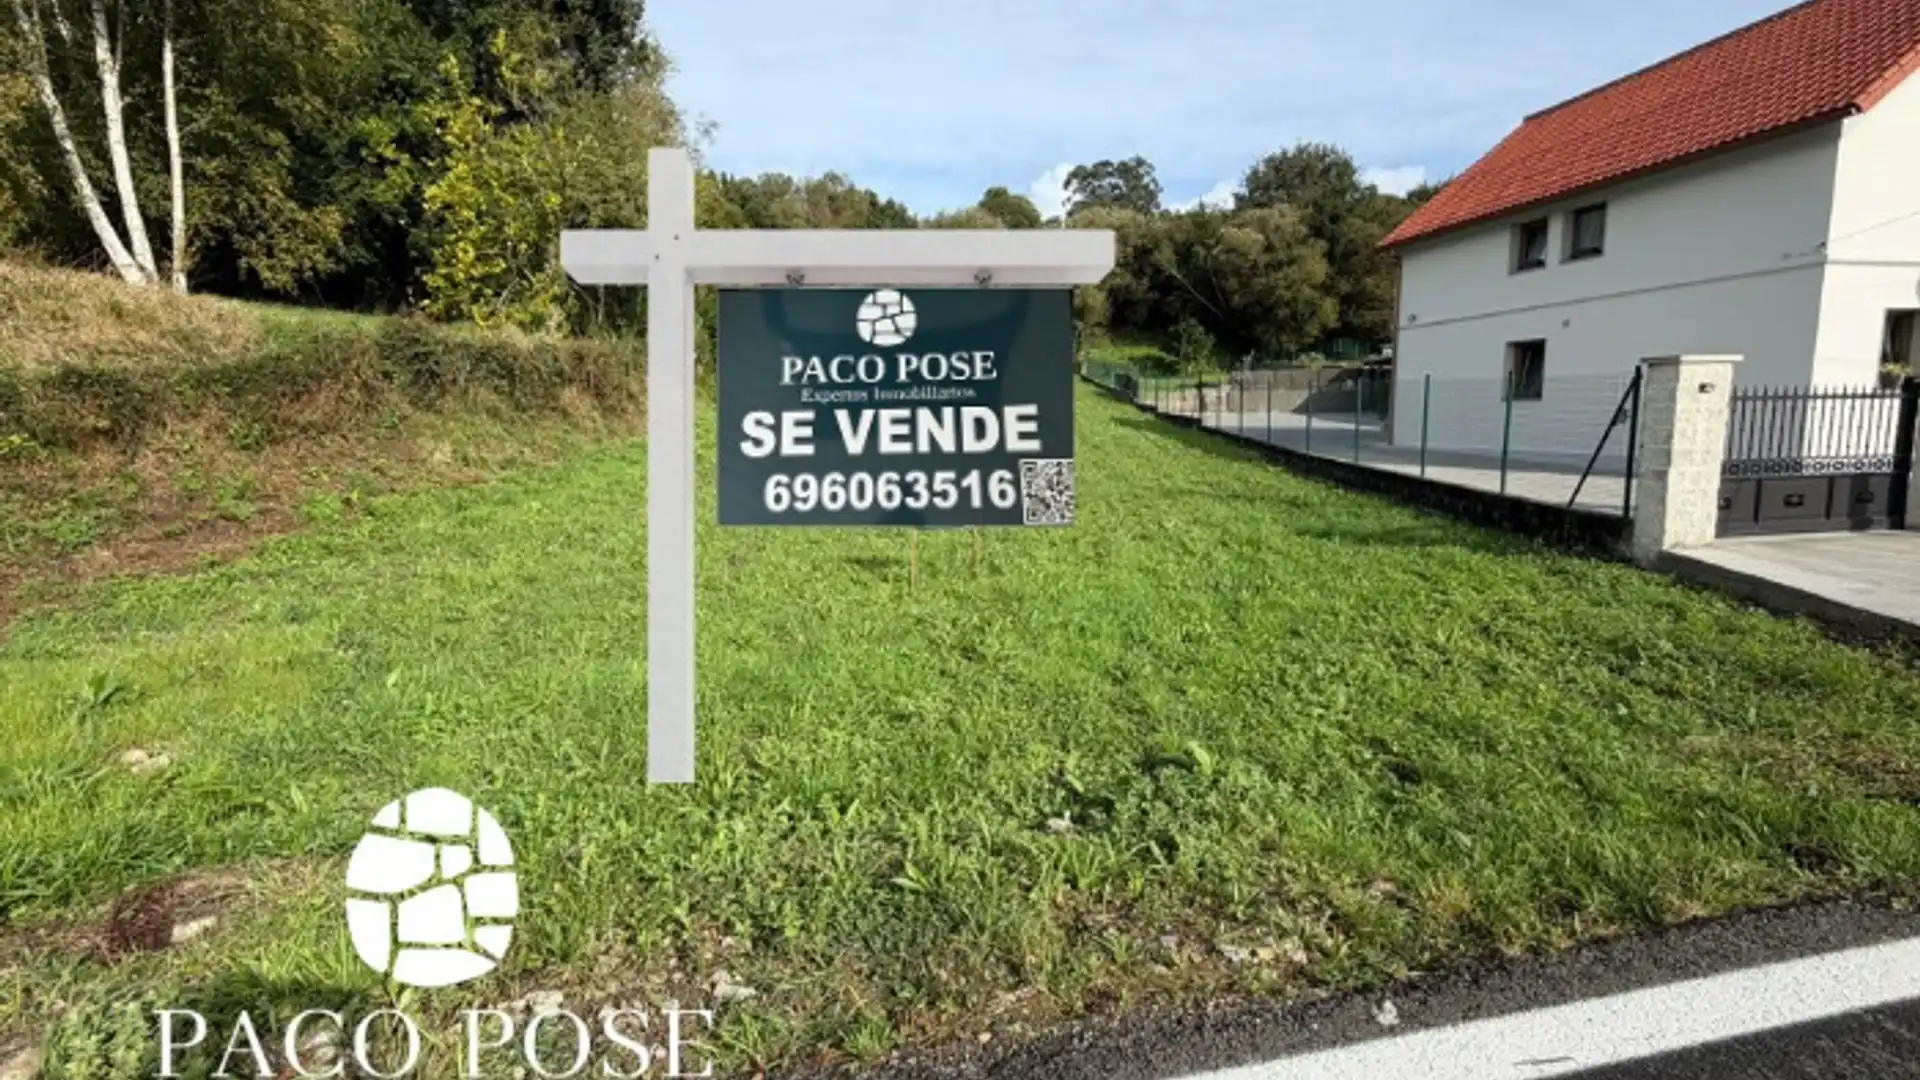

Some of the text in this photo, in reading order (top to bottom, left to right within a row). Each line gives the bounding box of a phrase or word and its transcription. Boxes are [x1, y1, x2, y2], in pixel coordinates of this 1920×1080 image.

[780, 350, 998, 386] PACO POSE
[740, 404, 1042, 457] SE VENDE
[764, 469, 1016, 513] 696063516
